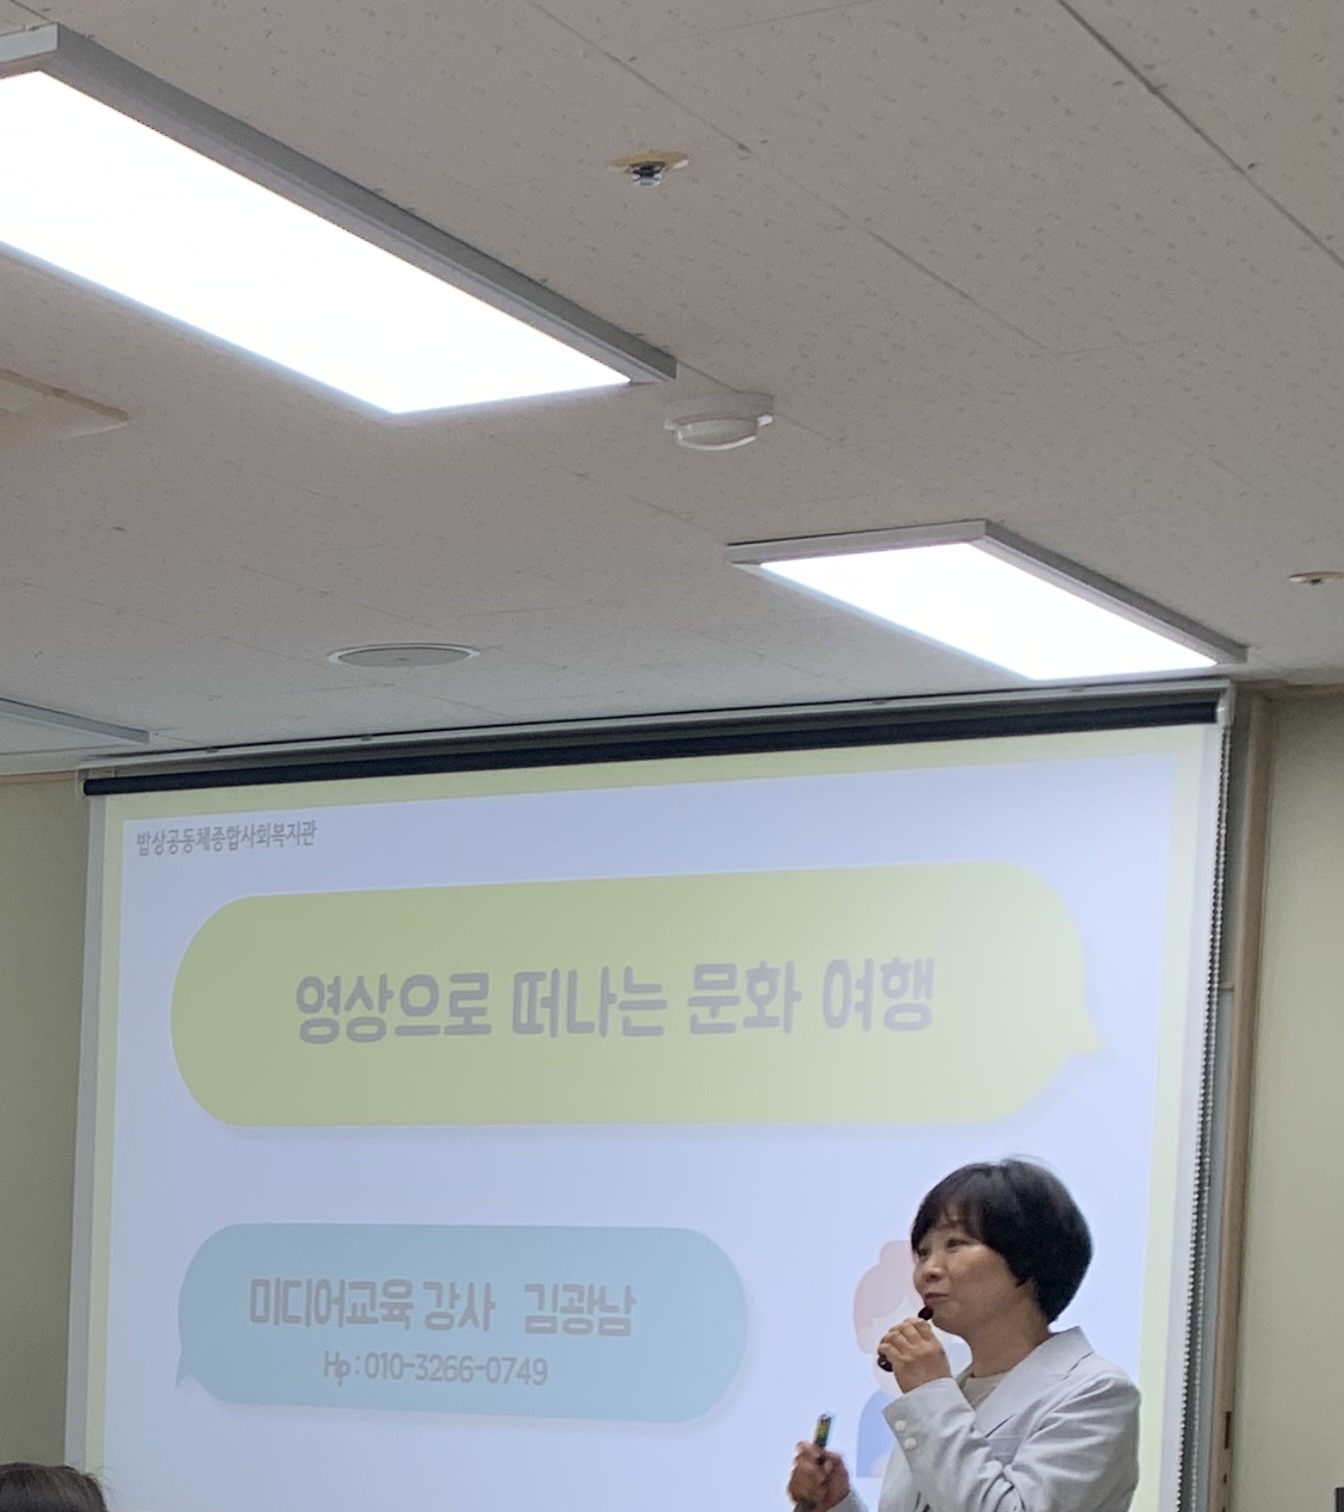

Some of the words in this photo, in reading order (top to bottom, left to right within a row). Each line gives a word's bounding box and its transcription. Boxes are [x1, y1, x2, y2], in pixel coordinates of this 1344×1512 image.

[137, 820, 316, 856] 밥상공동체종합사회복지관
[296, 972, 493, 1045] 영상으로
[511, 965, 668, 1038] 떠나는
[687, 960, 802, 1034] 문화
[822, 956, 936, 1033] 여행
[250, 1277, 415, 1330] 미디어교육
[422, 1281, 496, 1332] 강사
[524, 1282, 637, 1337] 김광남
